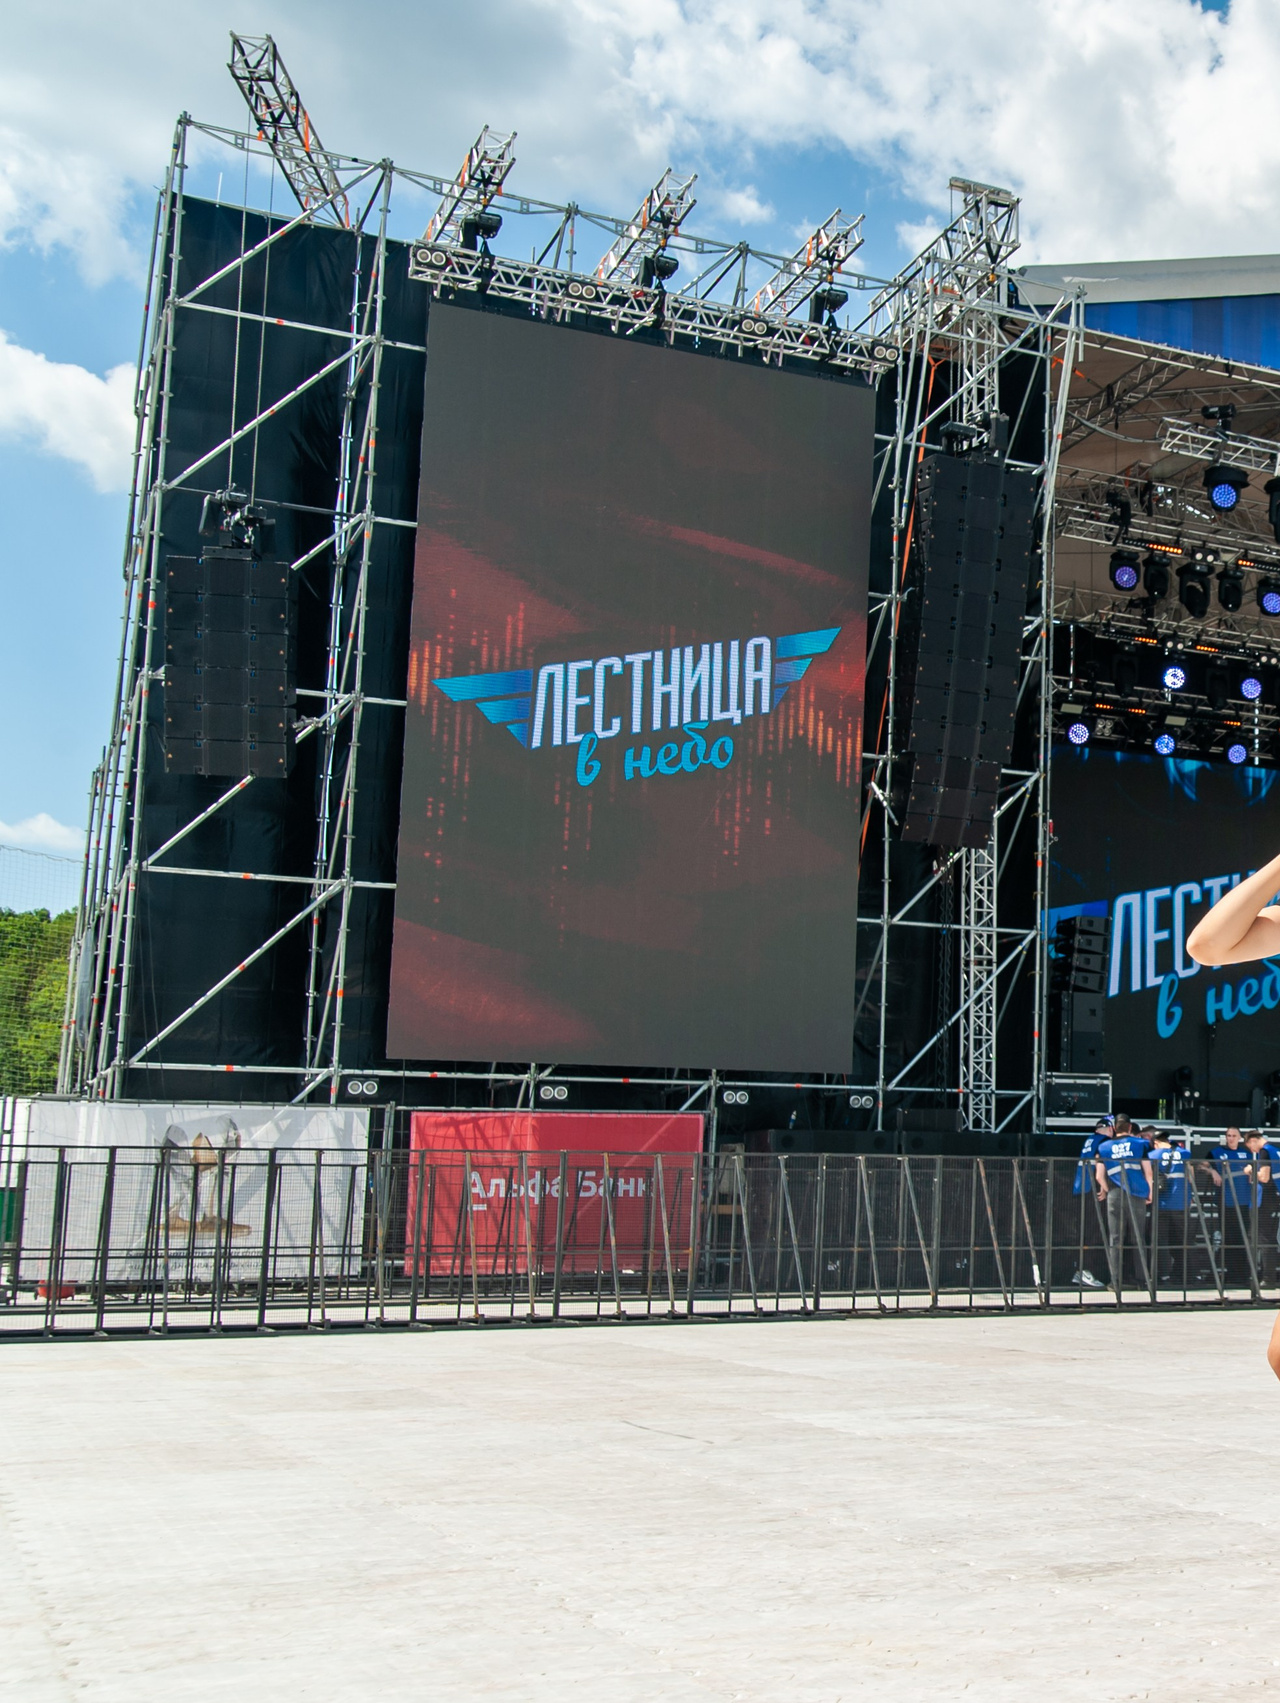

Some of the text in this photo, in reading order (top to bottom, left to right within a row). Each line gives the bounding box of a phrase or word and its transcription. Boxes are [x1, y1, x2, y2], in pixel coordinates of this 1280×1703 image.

[531, 636, 773, 750] ЛЕСТНИЦА
[576, 721, 734, 787] в небо
[1156, 973, 1183, 1039] в
